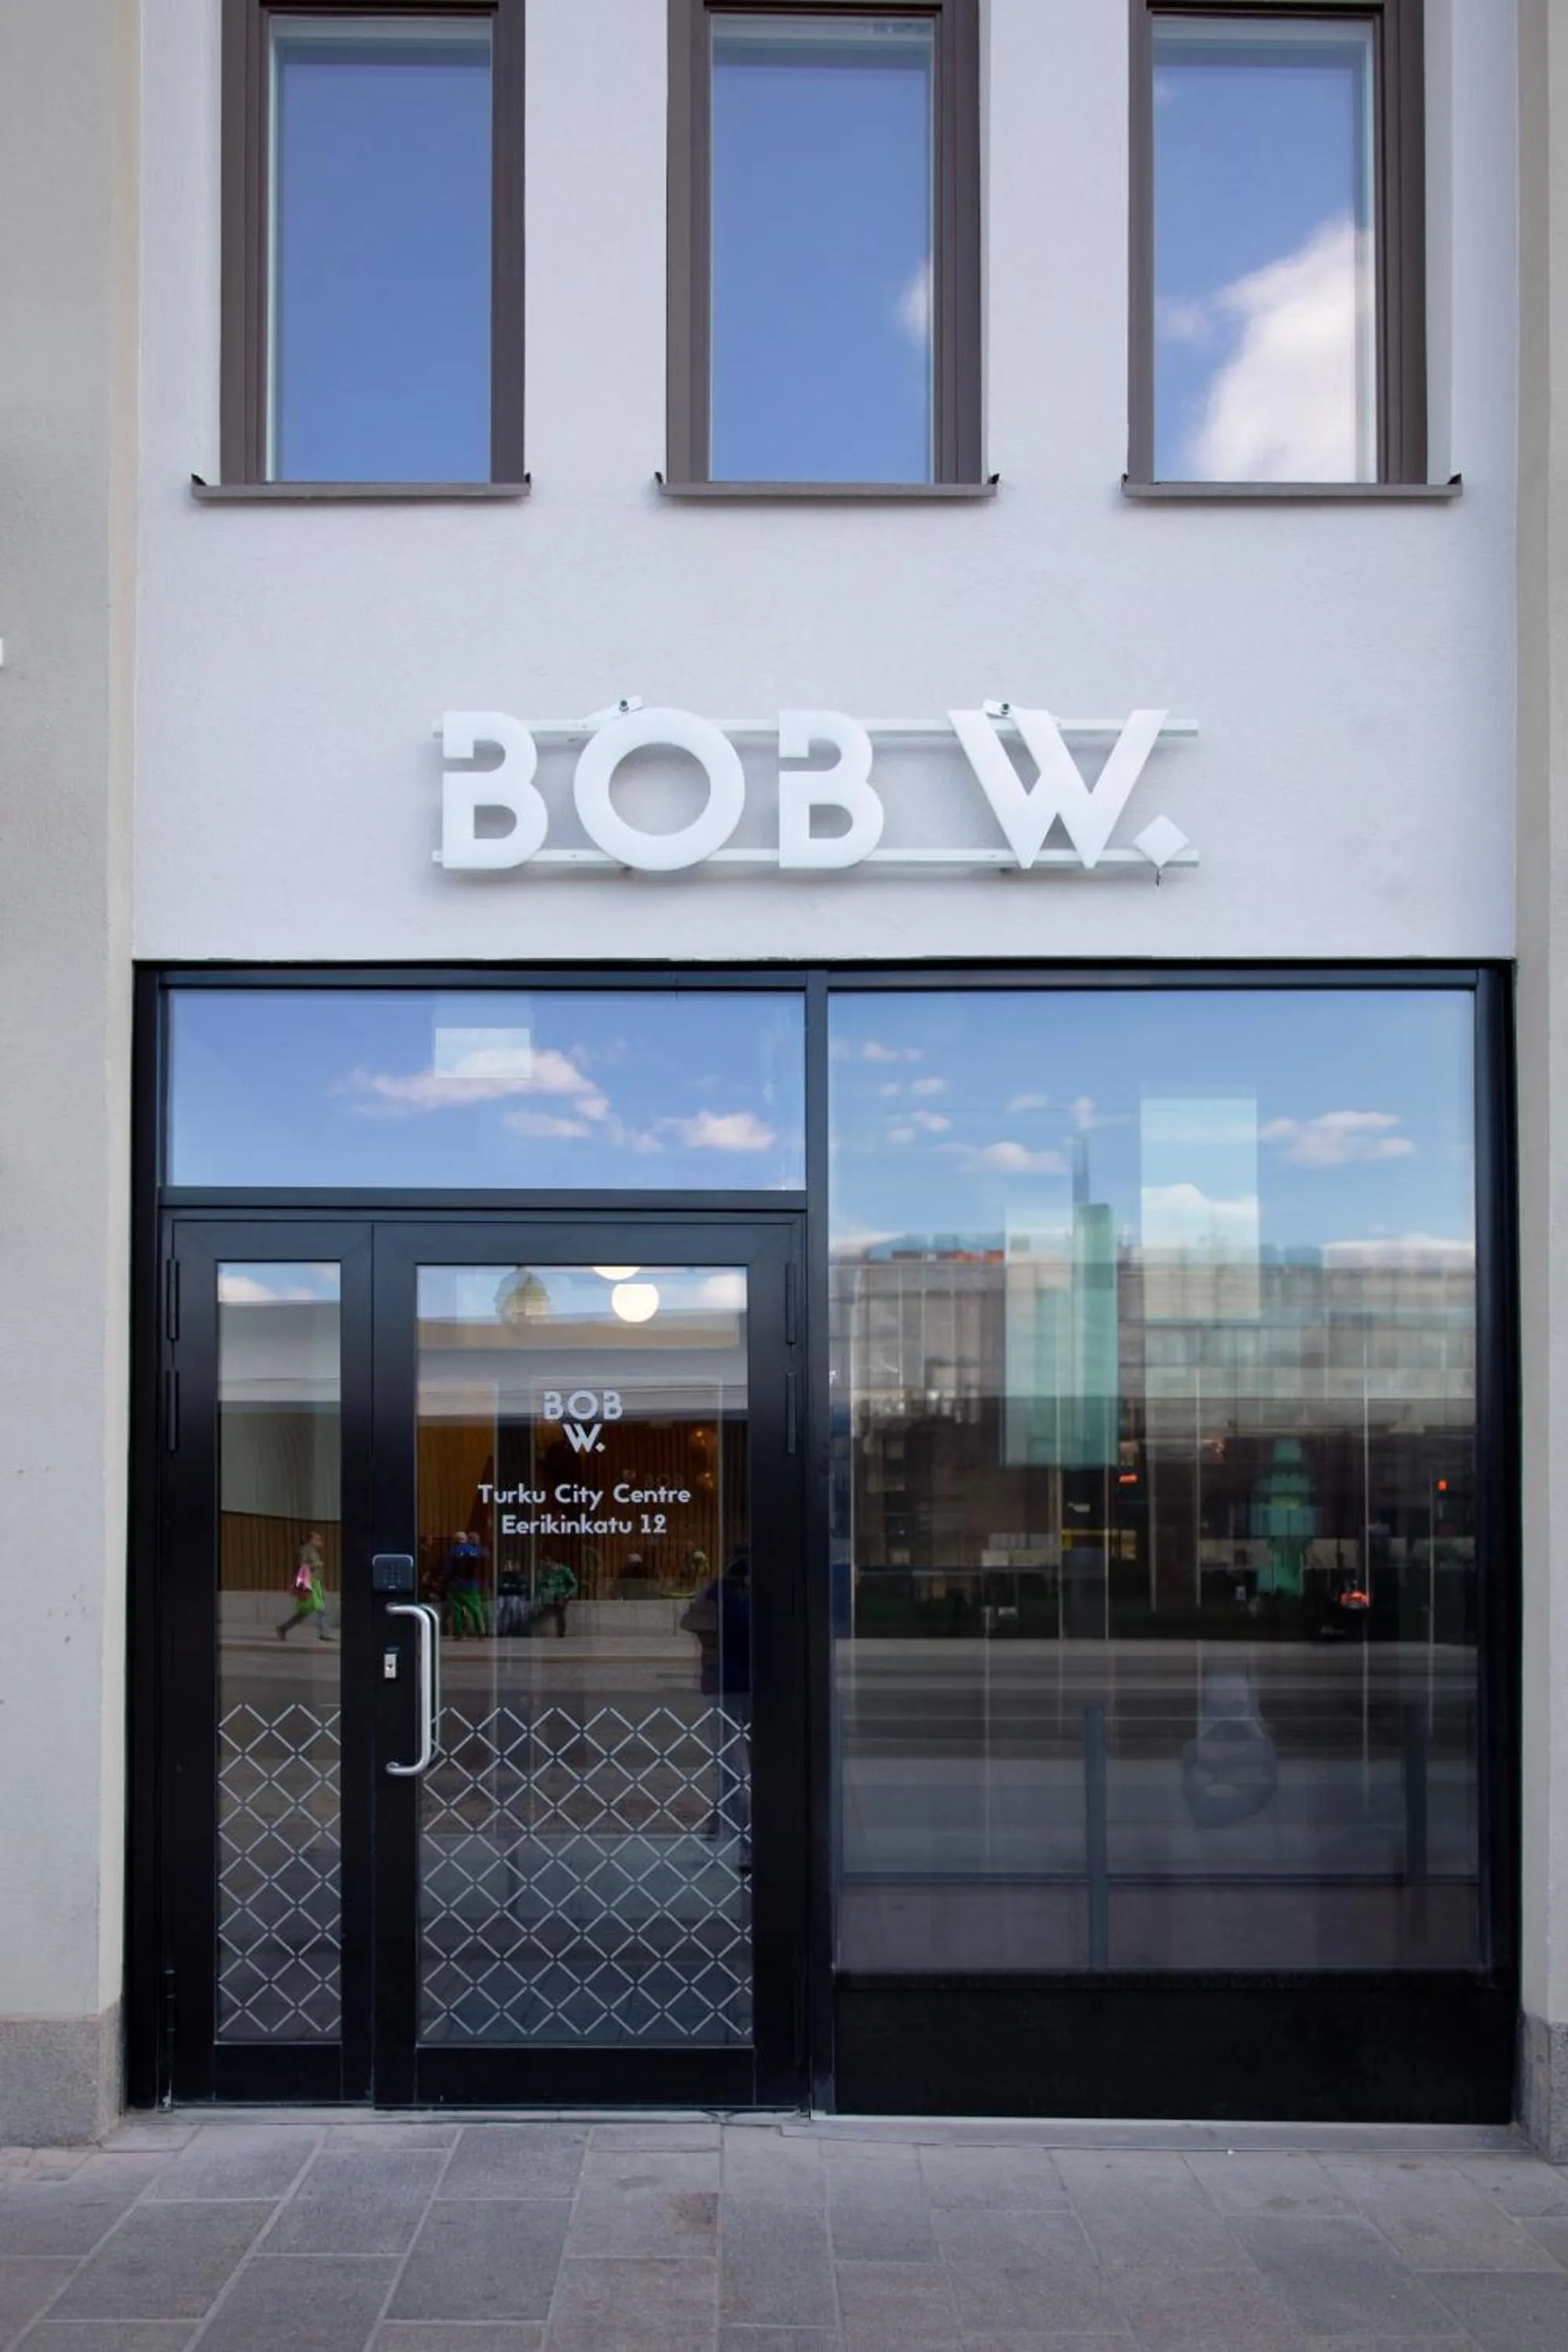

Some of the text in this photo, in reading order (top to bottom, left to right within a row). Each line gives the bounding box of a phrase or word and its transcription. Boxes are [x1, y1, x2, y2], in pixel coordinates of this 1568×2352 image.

[442, 706, 1190, 871] BOB W.
[543, 1390, 623, 1421] BOB
[562, 1423, 605, 1453] W.
[477, 1483, 691, 1512] Turku City Centre
[502, 1513, 666, 1534] Eerikinkatu 12
